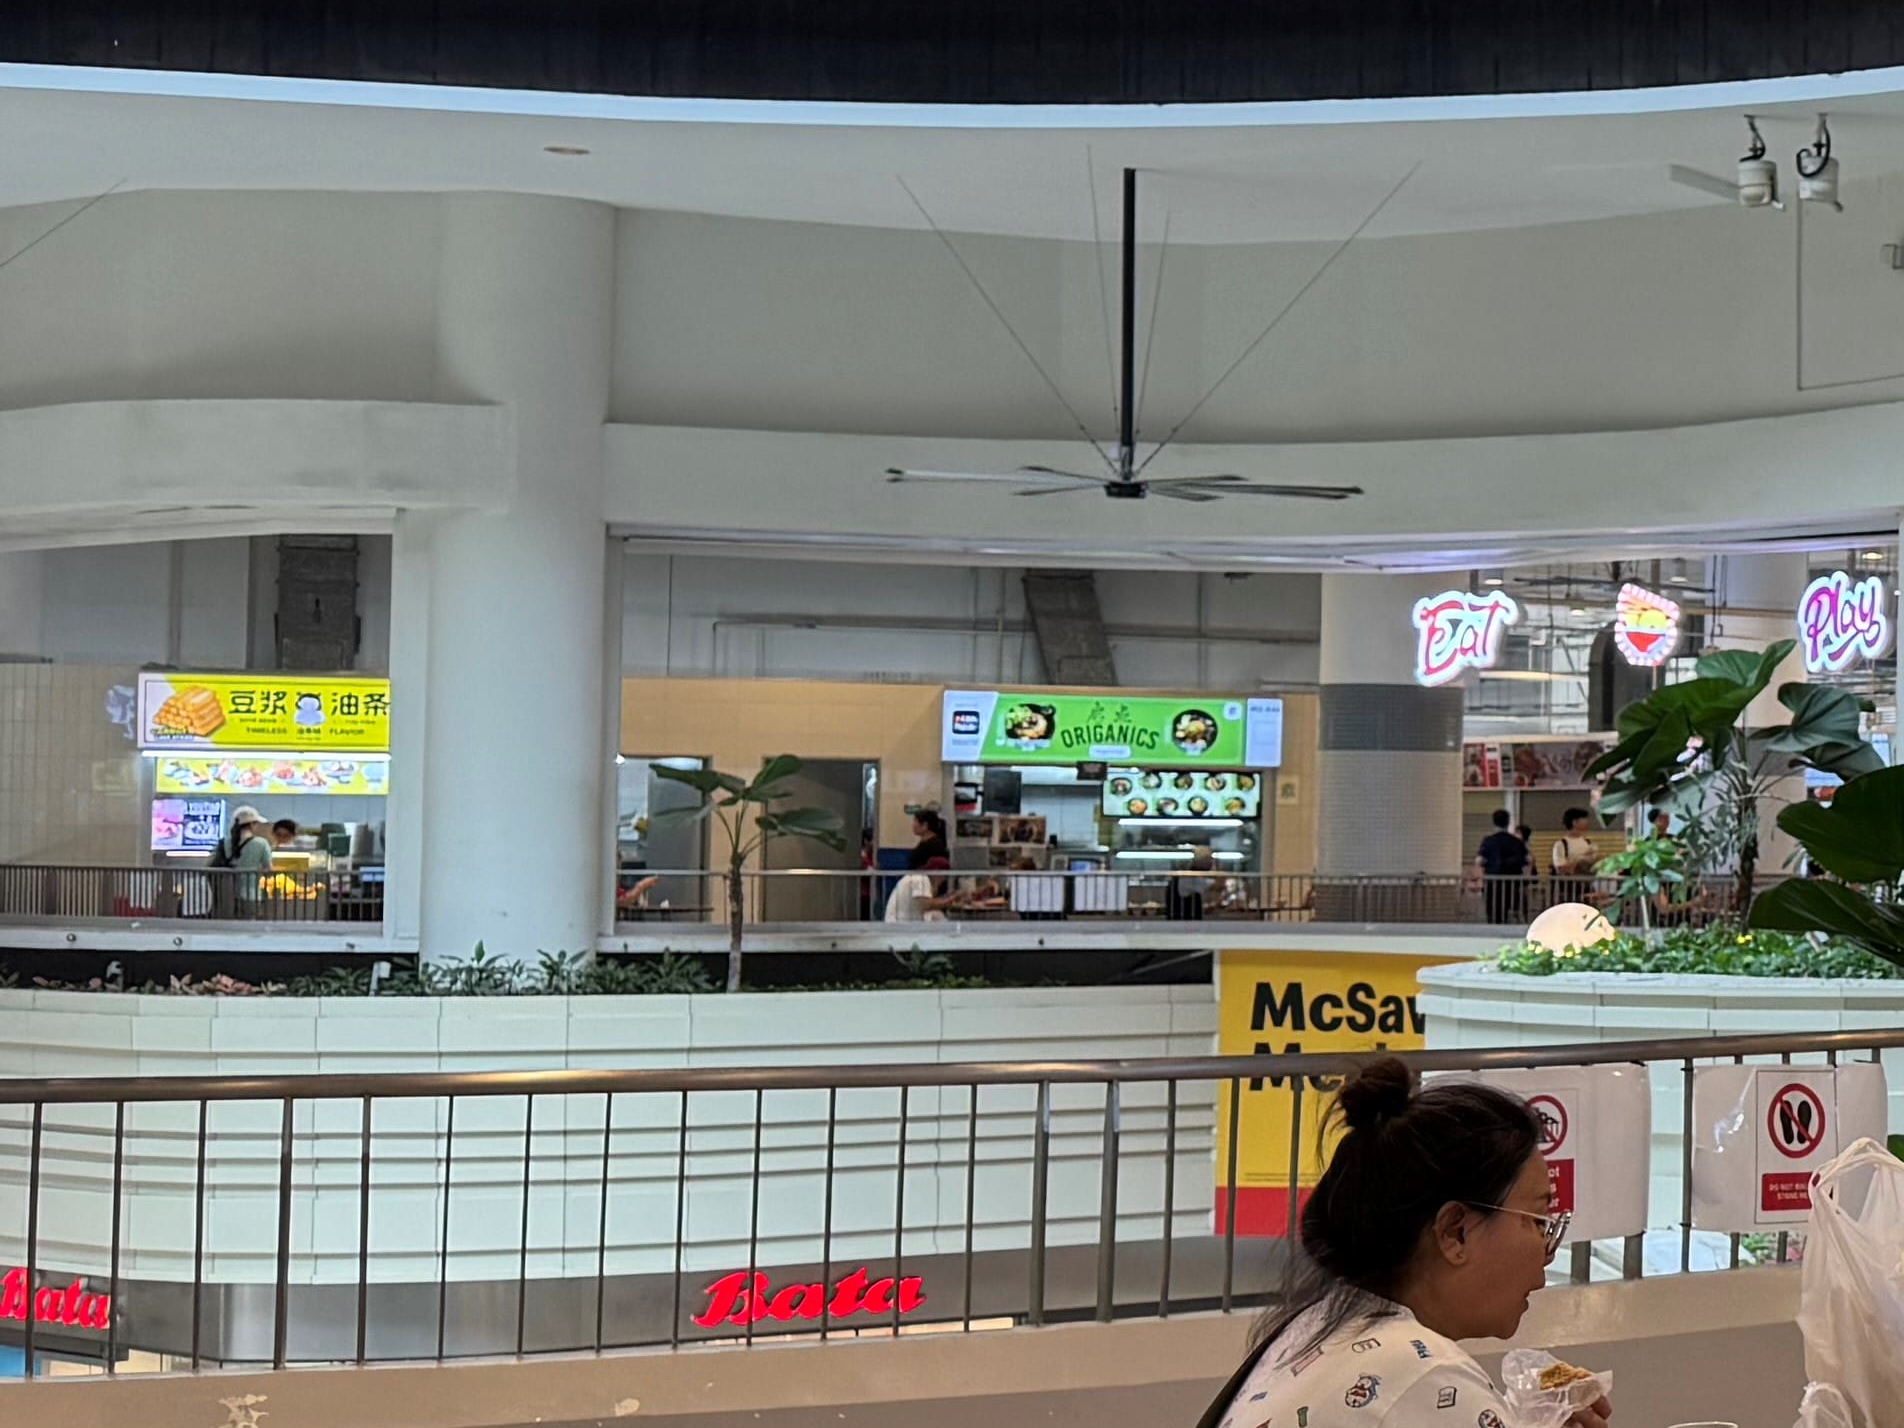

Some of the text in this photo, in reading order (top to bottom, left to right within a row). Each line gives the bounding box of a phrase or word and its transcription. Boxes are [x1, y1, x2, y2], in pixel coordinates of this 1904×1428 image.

[1801, 574, 1884, 667] Play
[228, 690, 287, 715] 豆浆
[1060, 723, 1160, 750] ORIGANICS
[690, 1266, 927, 1328] Bata
